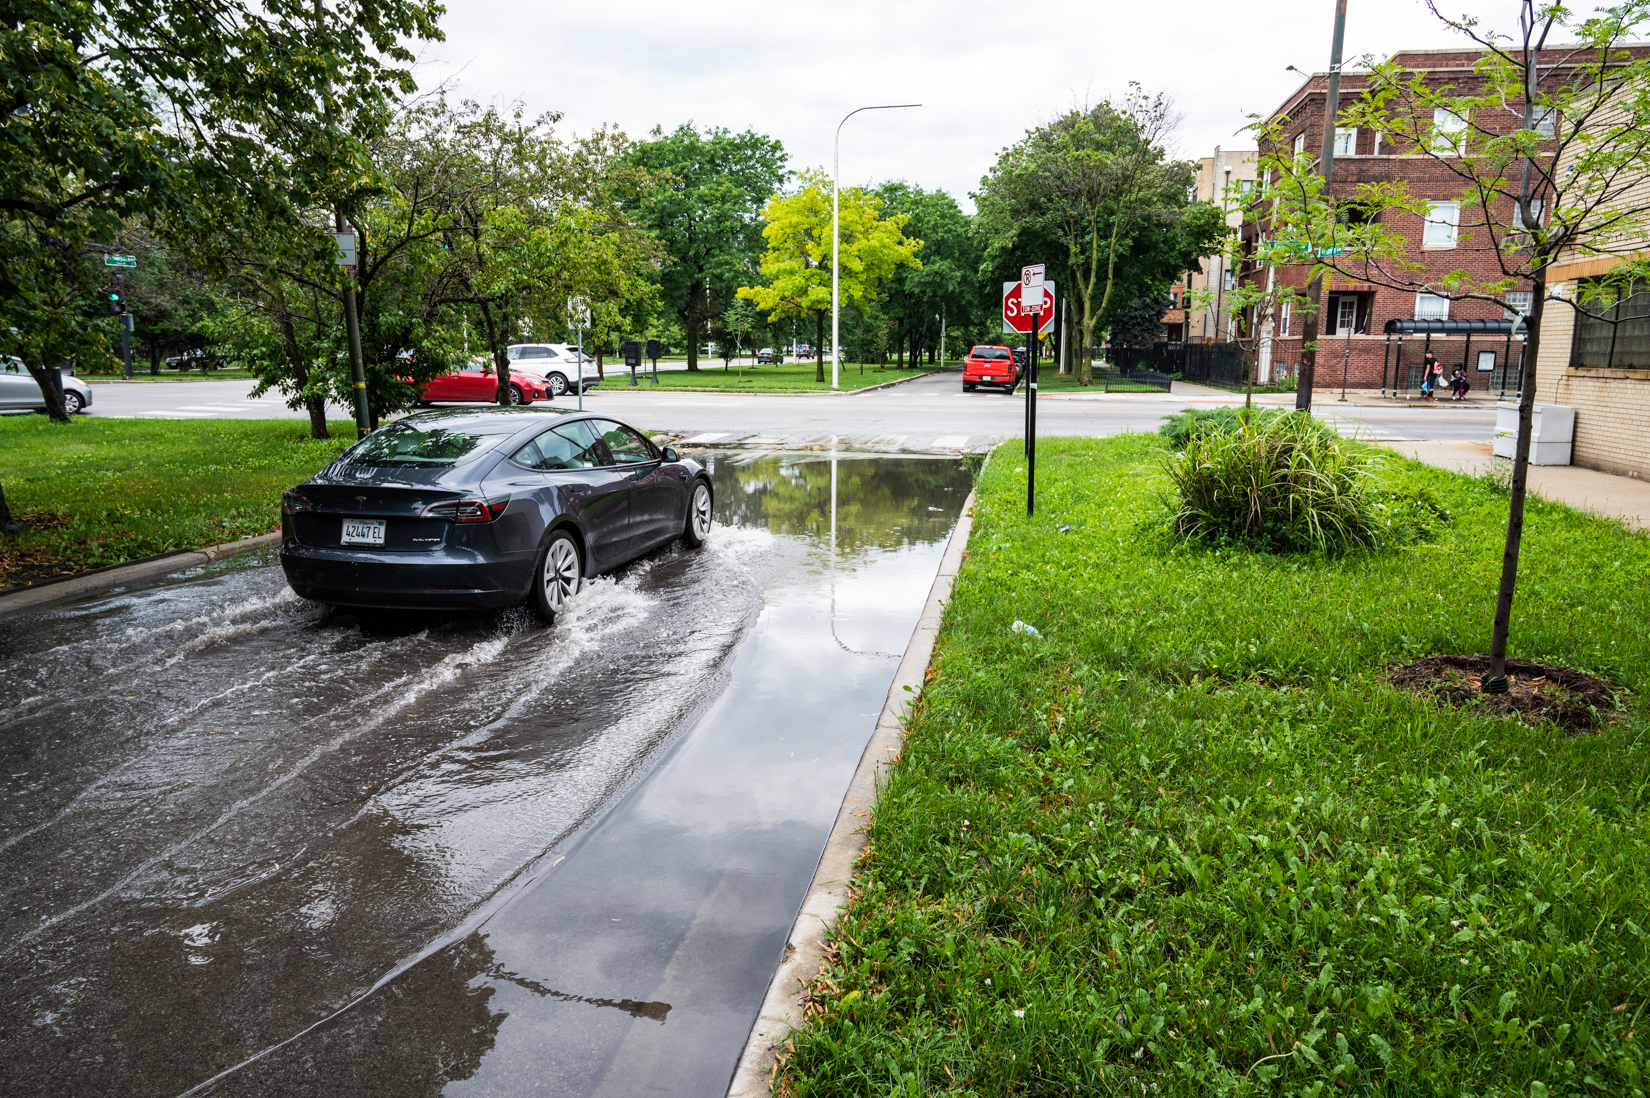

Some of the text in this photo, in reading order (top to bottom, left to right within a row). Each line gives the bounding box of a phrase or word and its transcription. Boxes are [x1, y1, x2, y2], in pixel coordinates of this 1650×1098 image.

[1007, 298, 1051, 316] SP
[346, 525, 382, 539] 42447 EL
